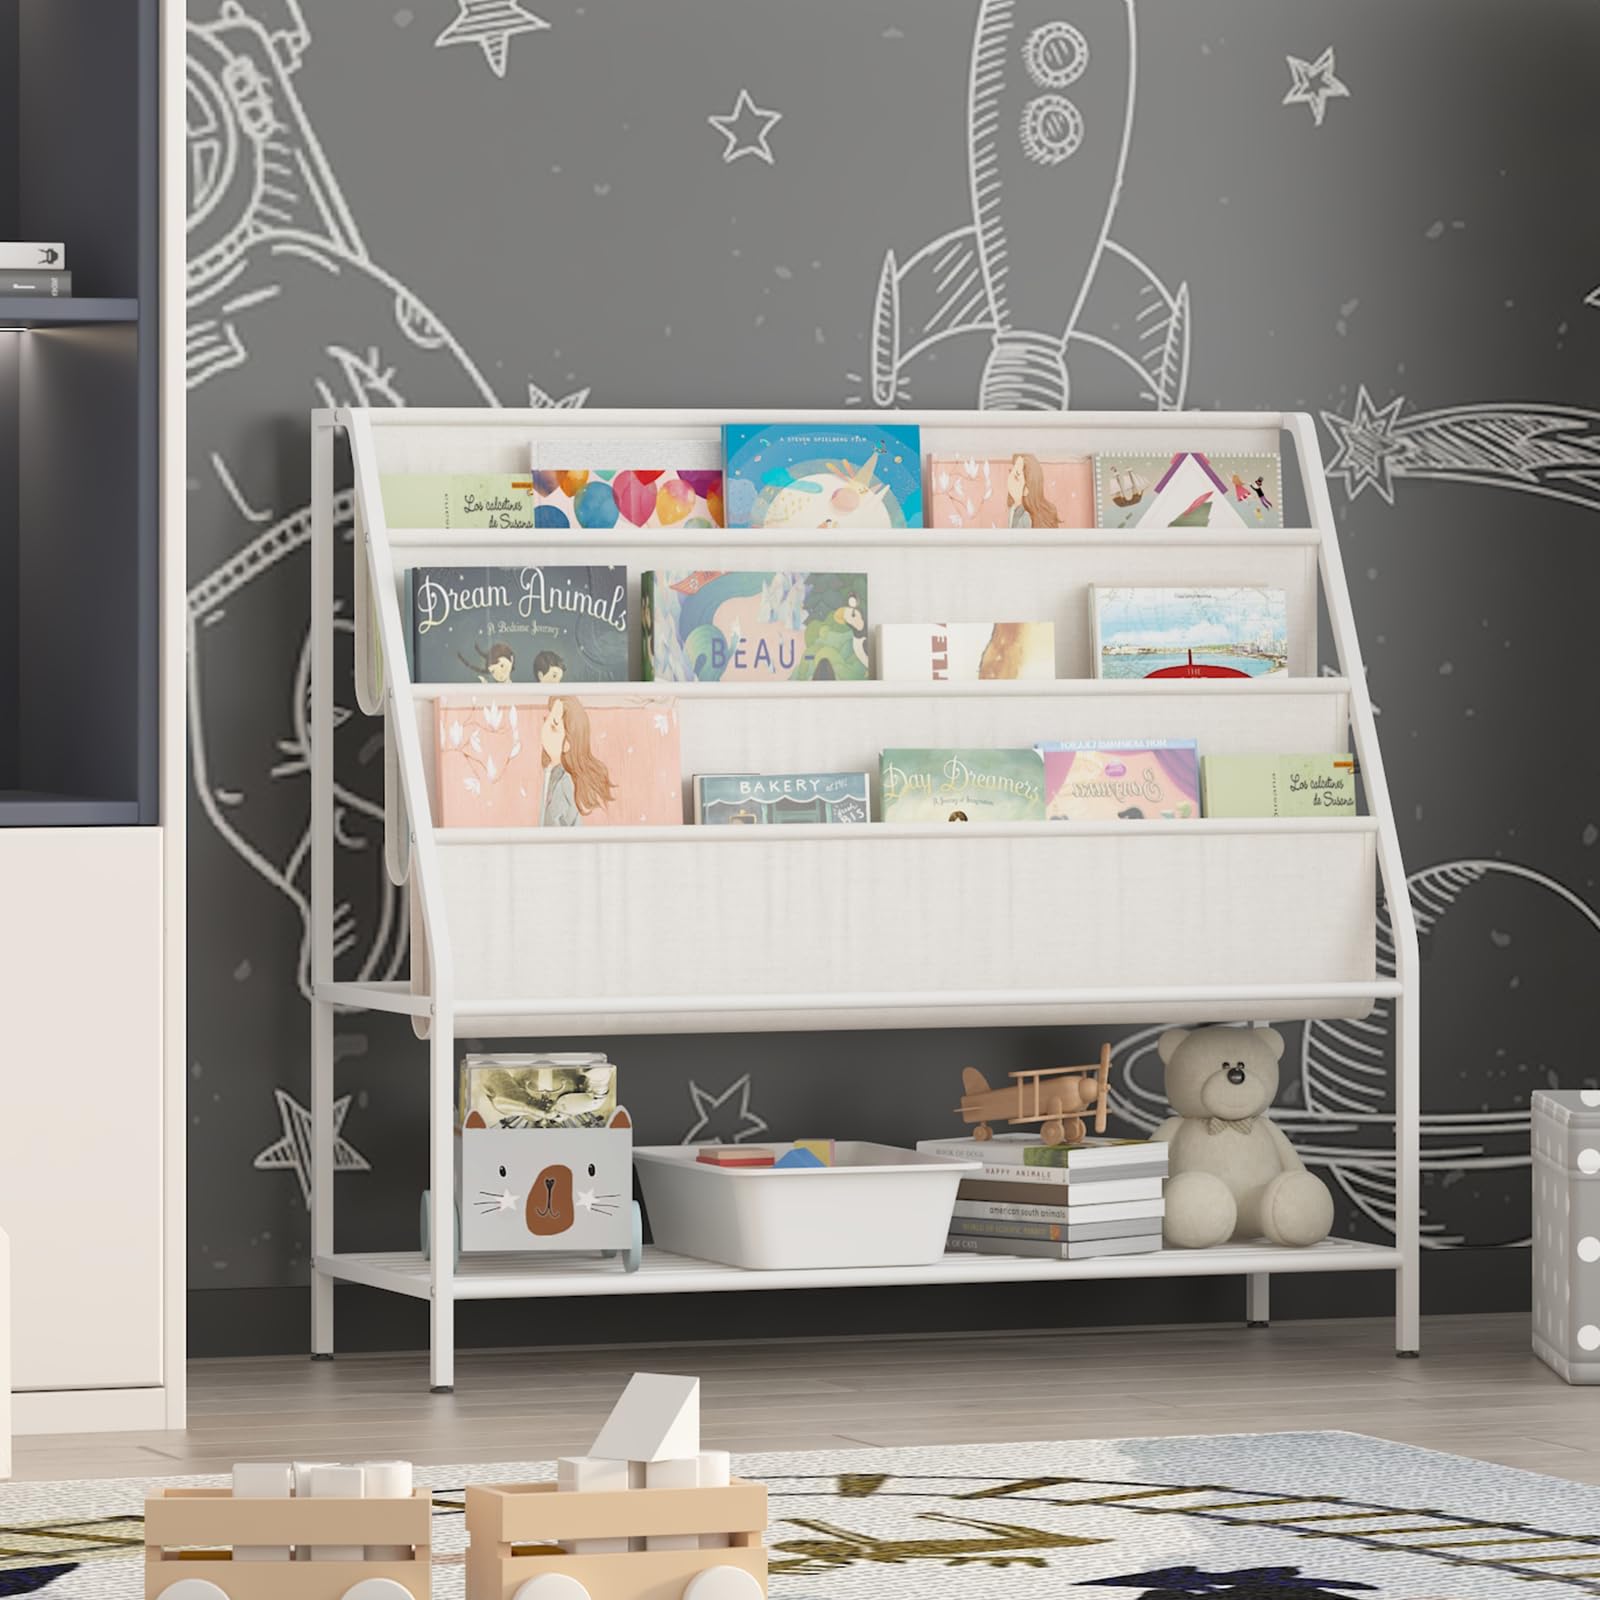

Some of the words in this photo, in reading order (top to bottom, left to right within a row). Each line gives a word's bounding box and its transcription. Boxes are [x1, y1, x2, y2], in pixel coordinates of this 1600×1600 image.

[463, 494, 483, 513] Los
[485, 496, 522, 511] calcetines
[488, 515, 498, 528] de
[417, 575, 512, 634] Dream
[518, 566, 627, 632] Animals
[487, 622, 495, 635] A
[497, 621, 529, 633] Bedtime
[531, 620, 560, 638] Journey
[882, 762, 932, 800] Day
[940, 754, 1040, 801] Dreamers
[1289, 773, 1308, 792] Los
[1309, 776, 1344, 790] calcetines
[739, 779, 820, 794] BAKERY
[1313, 793, 1321, 806] de
[1323, 791, 1354, 807] Susana
[985, 1168, 1010, 1177] HAPPY
[1016, 1169, 1051, 1179] ANIMALS
[989, 1206, 1020, 1216] american
[1021, 1207, 1039, 1217] south
[1040, 1208, 1066, 1218] animals
